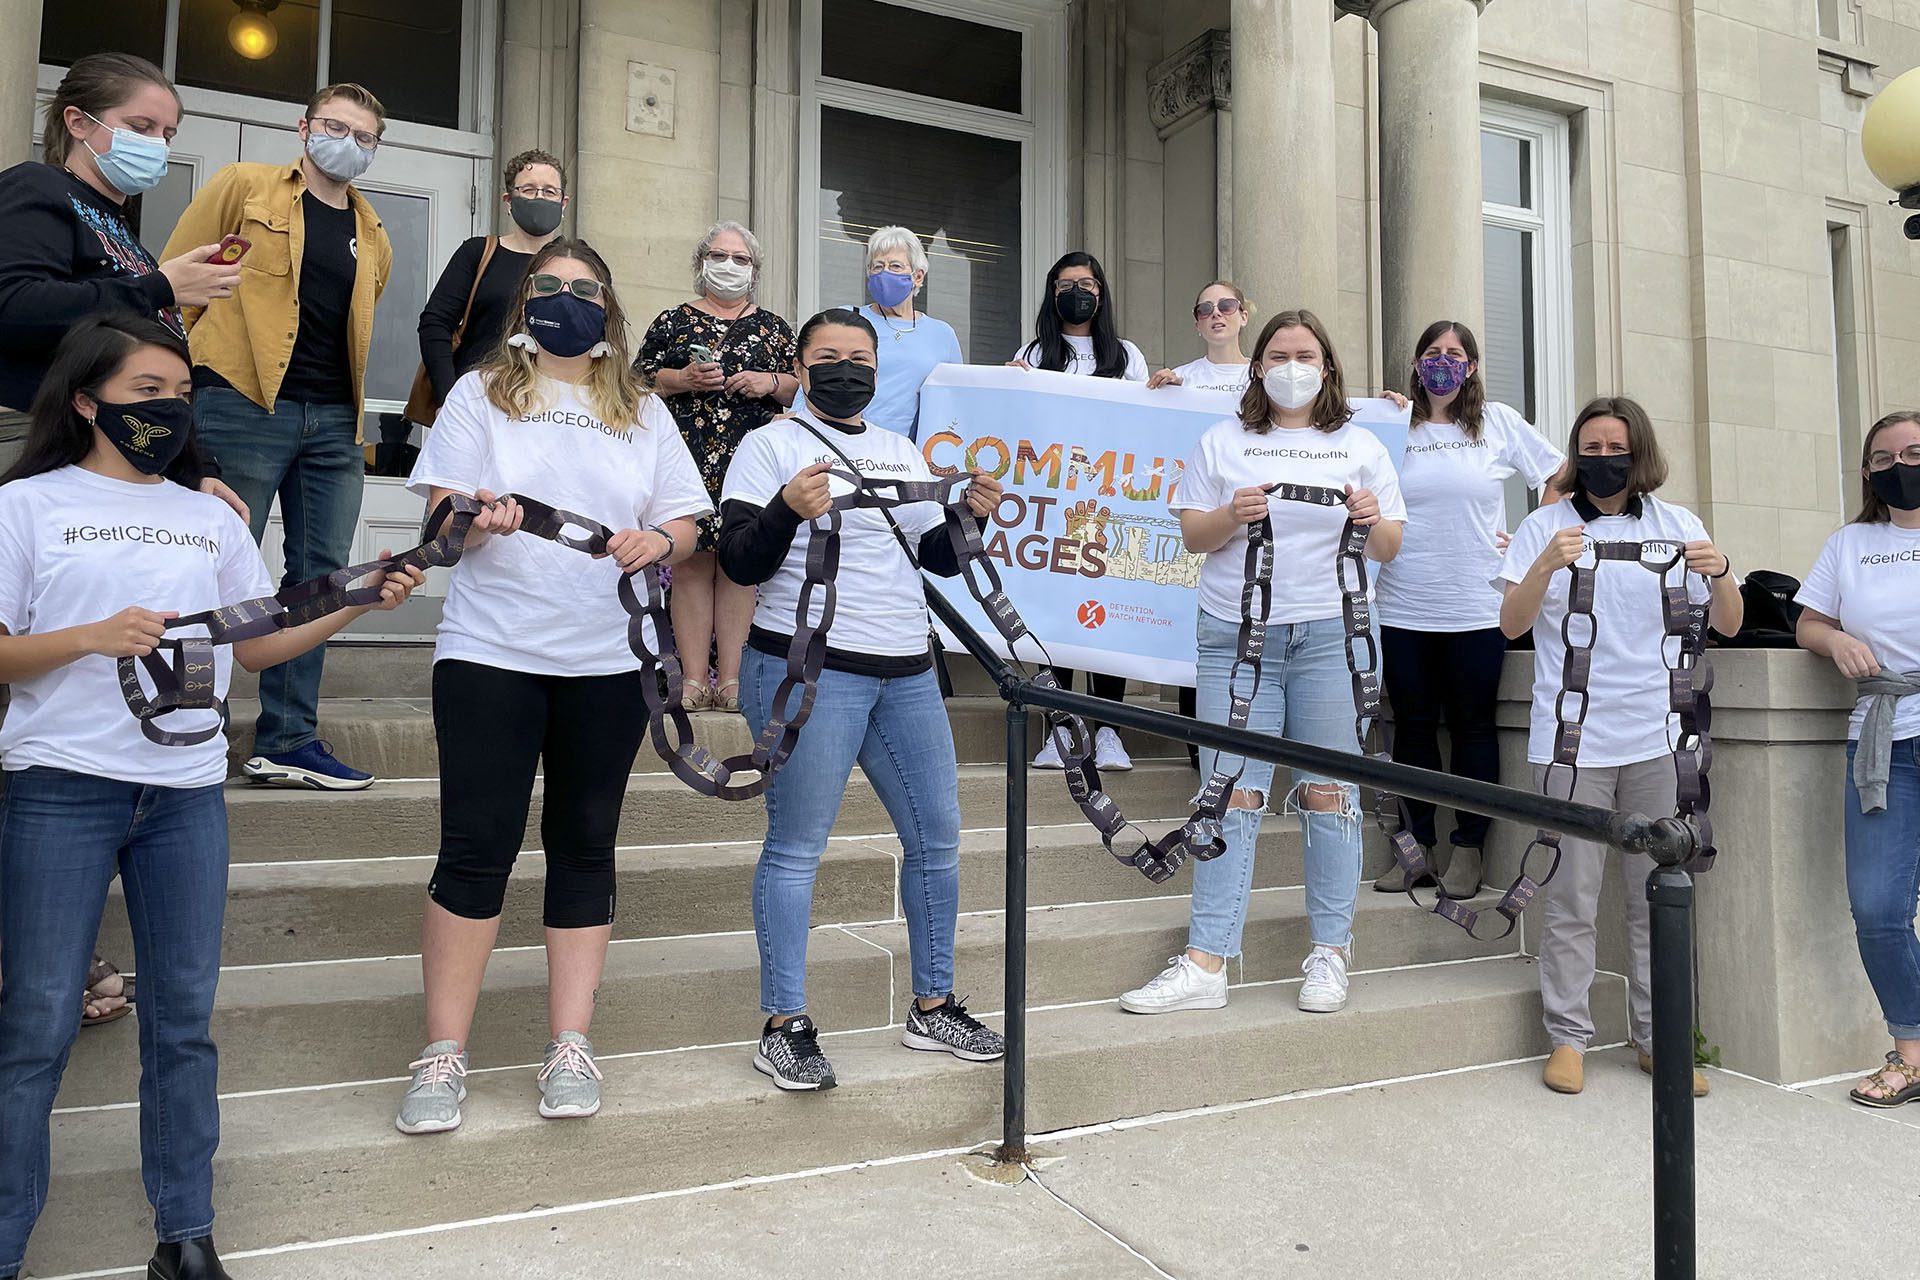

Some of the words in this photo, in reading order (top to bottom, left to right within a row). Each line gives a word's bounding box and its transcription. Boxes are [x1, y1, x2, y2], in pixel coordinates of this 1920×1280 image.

[1243, 447, 1348, 460] #GetICEOutofIN
[961, 489, 1057, 542] OT
[63, 525, 220, 555] #GetICEOutofIN
[984, 530, 1107, 579] AGES
[1108, 611, 1134, 621] WATCH
[1135, 616, 1173, 626] NETWORK
[1109, 602, 1154, 615] DETENTION
